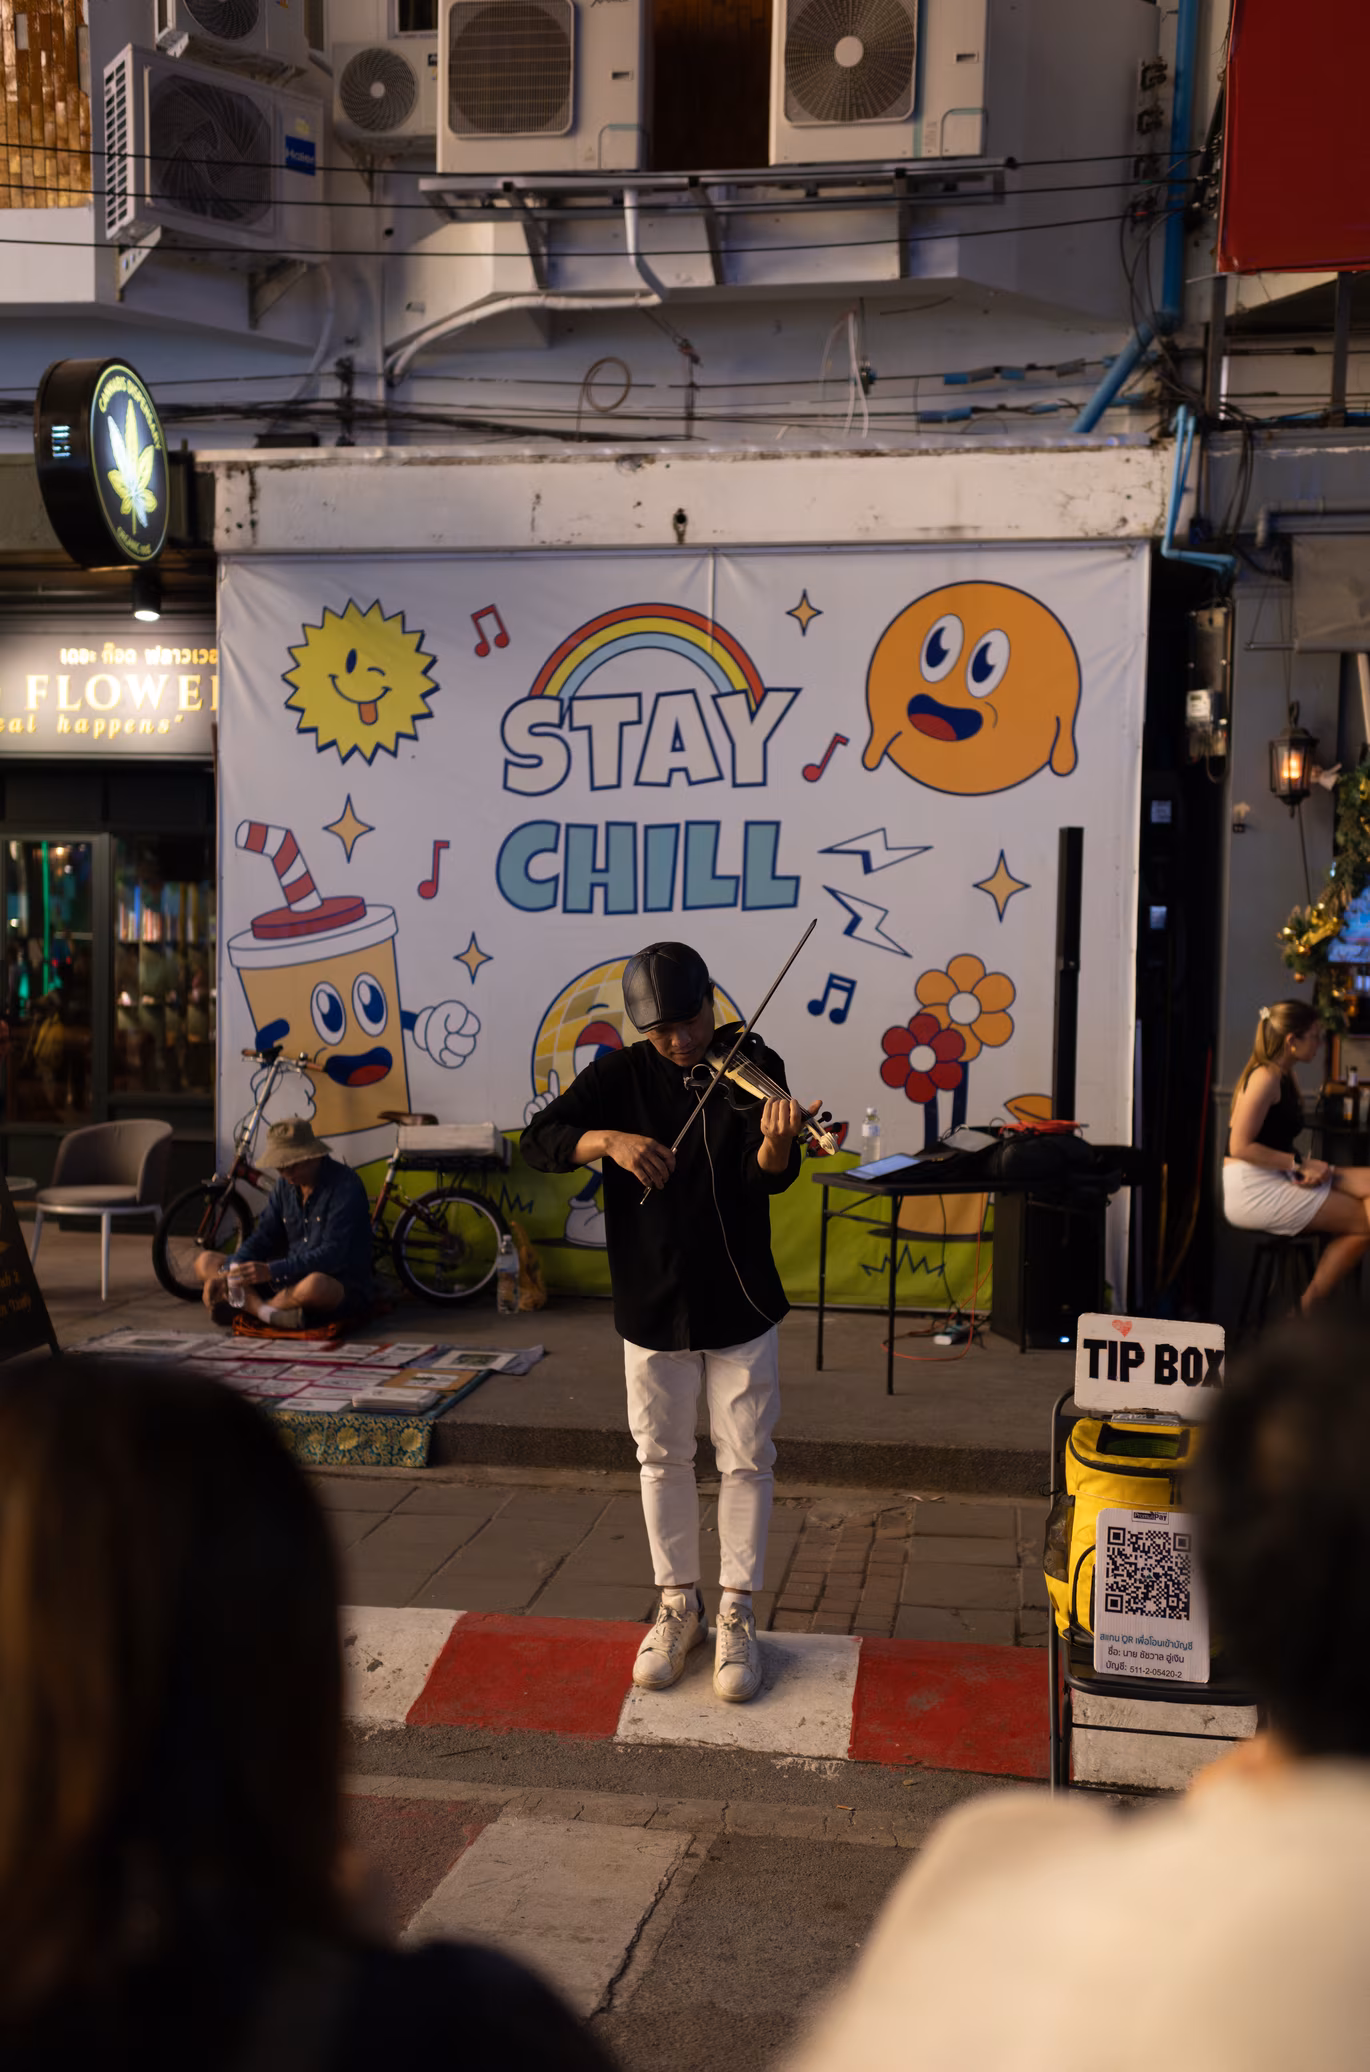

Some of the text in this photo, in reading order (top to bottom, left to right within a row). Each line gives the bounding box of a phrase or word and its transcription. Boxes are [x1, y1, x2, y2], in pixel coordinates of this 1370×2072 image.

[500, 687, 803, 797] STAY
[495, 819, 801, 916] CHILL
[1083, 1338, 1226, 1389] TIP BOX
[1121, 1635, 1134, 1645] QR
[1122, 1649, 1138, 1658] นาย
[1130, 1666, 1182, 1678] 511-2-05420-2
